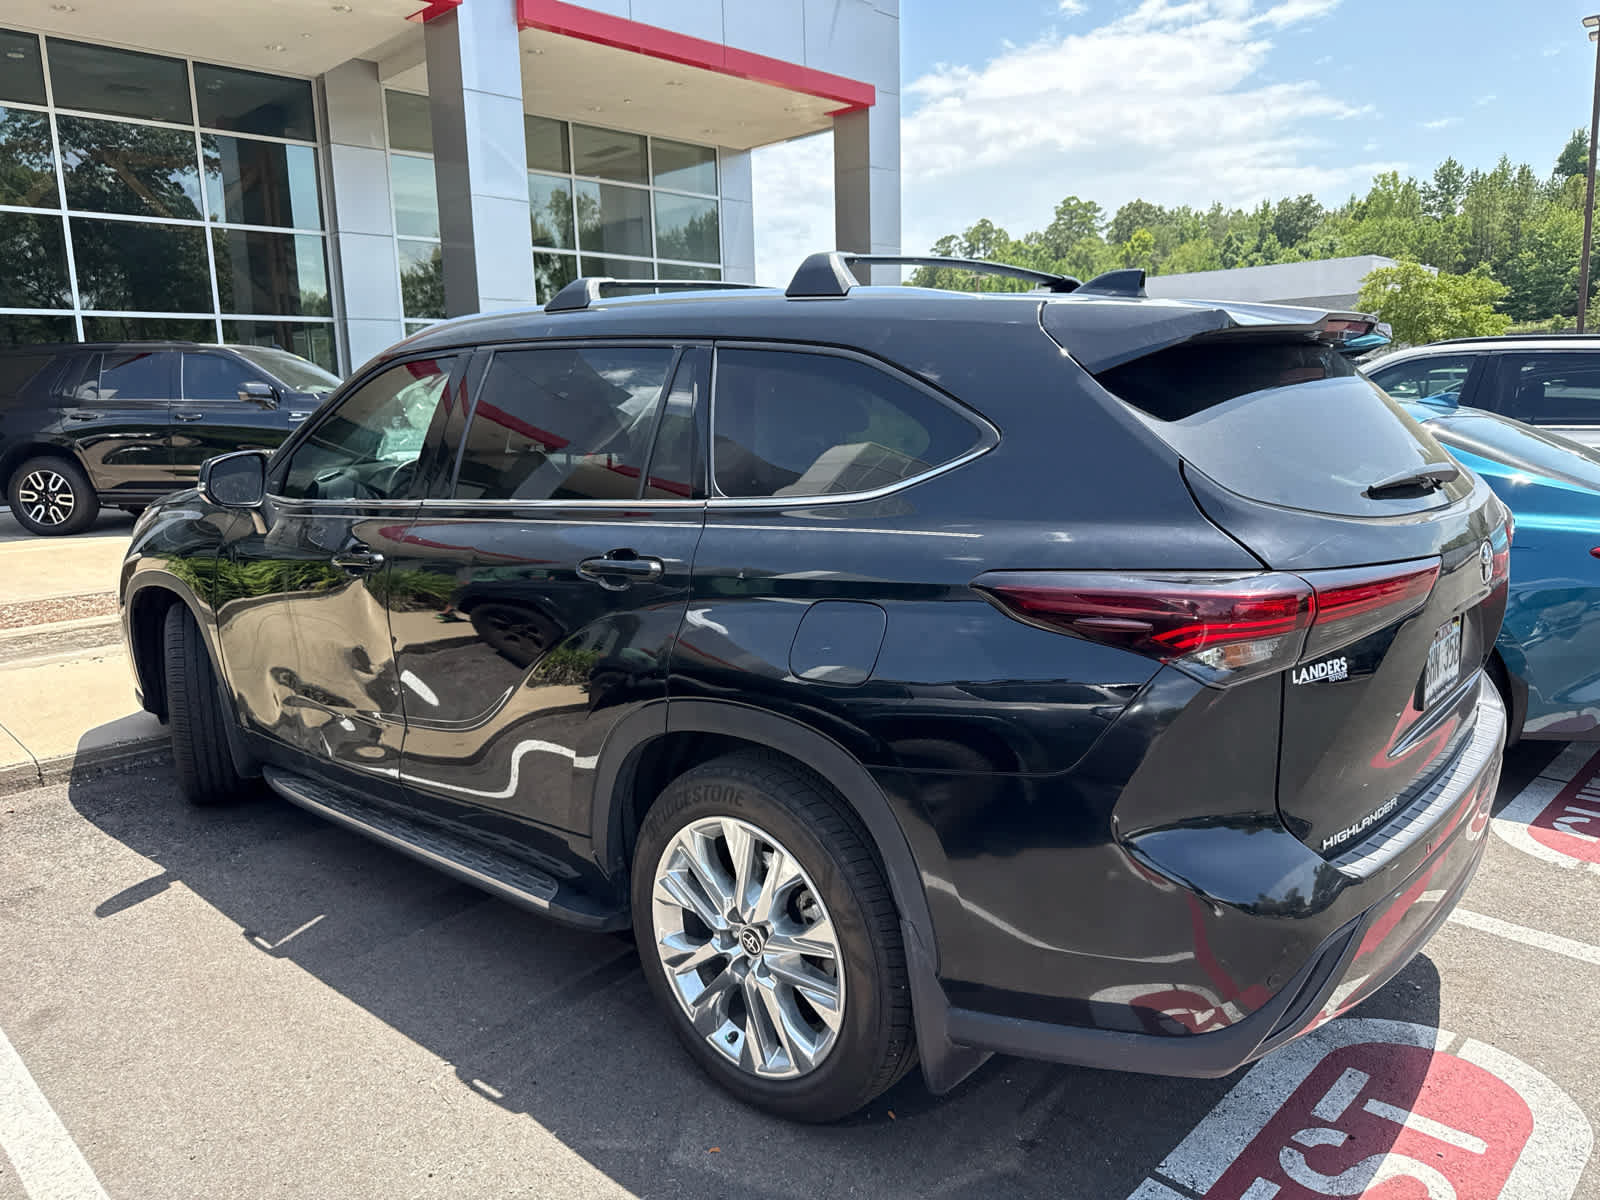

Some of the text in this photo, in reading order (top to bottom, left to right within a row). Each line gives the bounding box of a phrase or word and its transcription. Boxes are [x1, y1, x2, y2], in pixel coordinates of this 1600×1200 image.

[1292, 656, 1348, 685] LANDERS
[1329, 671, 1348, 682] TOYOTA
[1322, 797, 1398, 851] HIGHLANDER
